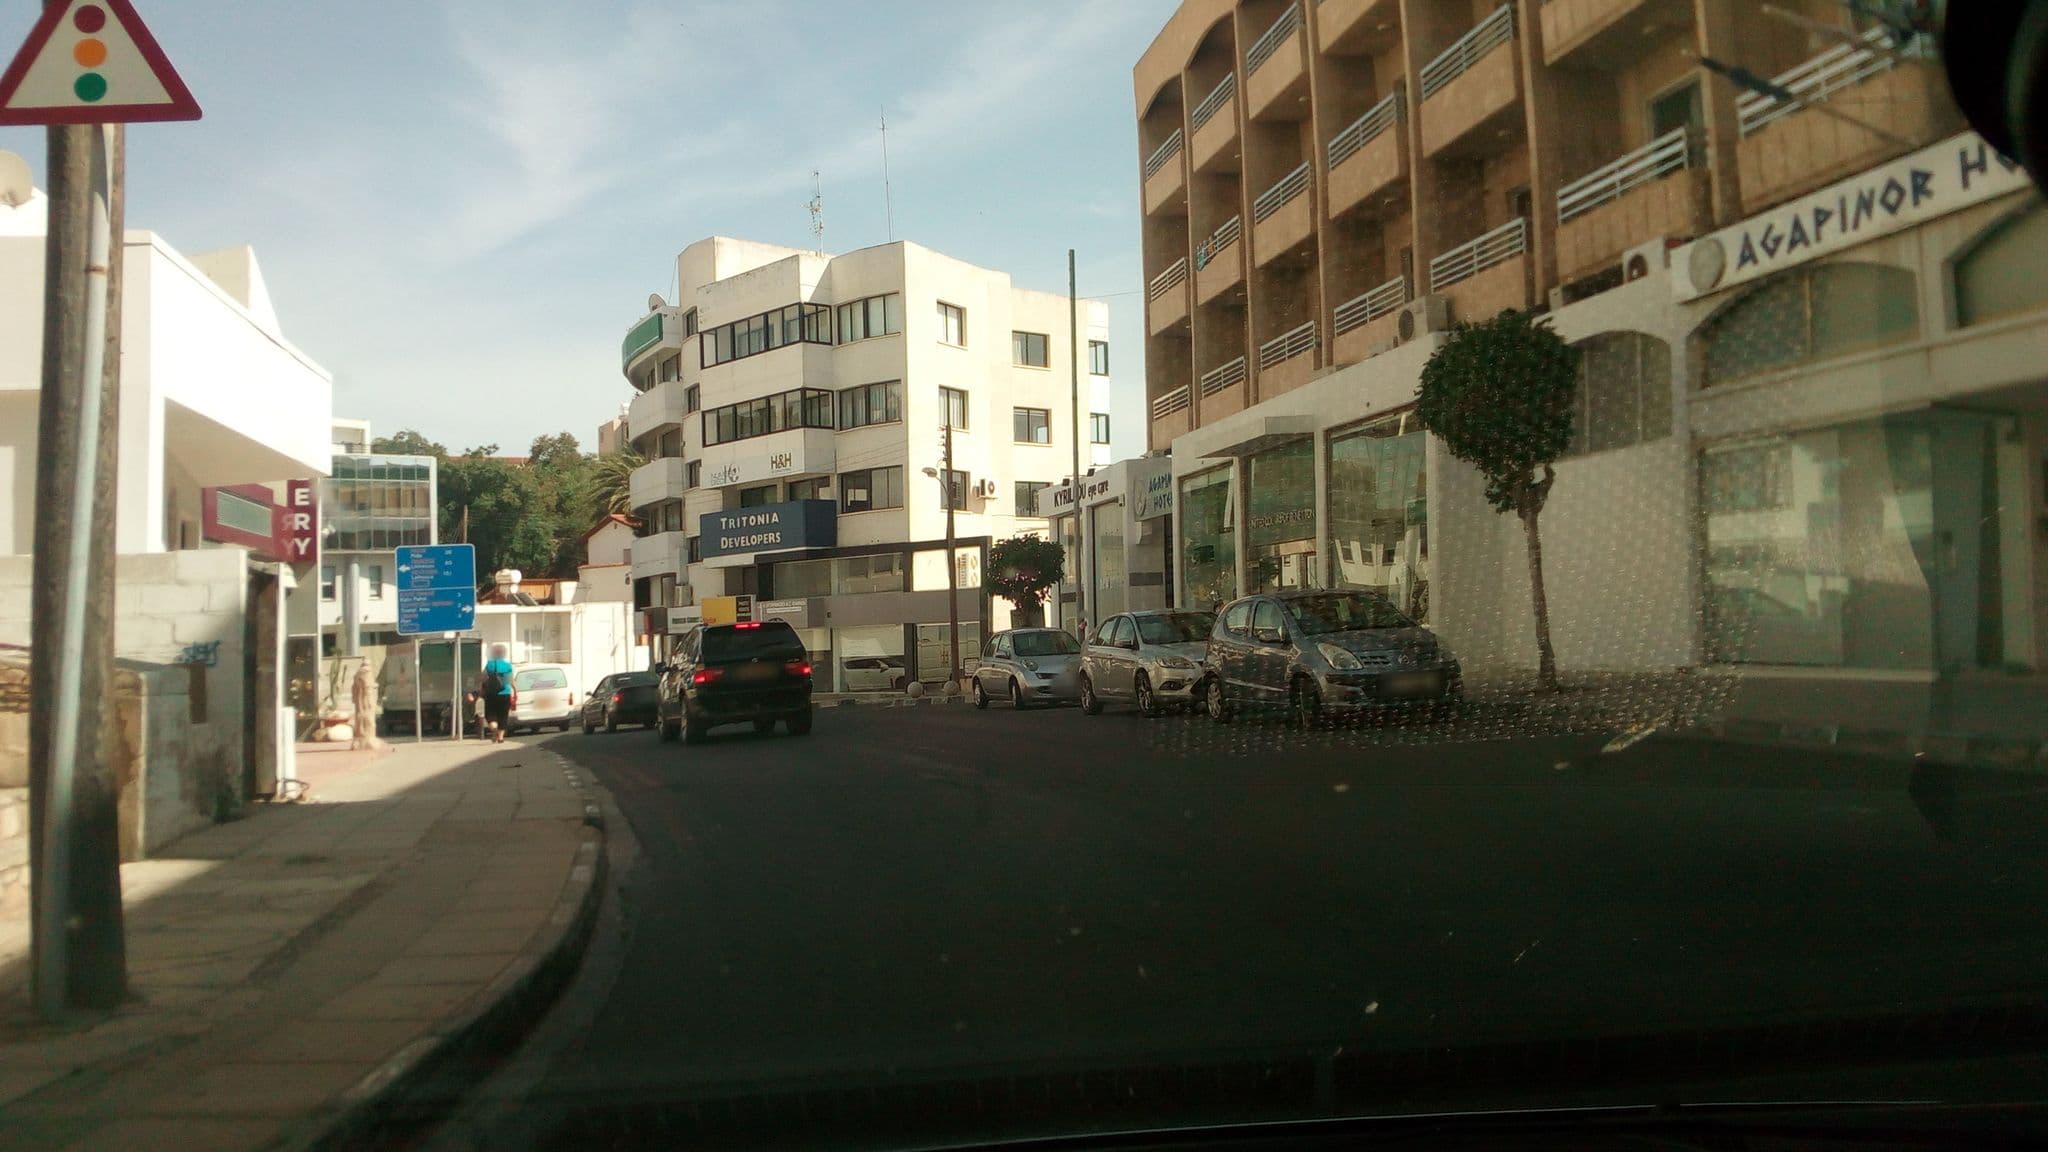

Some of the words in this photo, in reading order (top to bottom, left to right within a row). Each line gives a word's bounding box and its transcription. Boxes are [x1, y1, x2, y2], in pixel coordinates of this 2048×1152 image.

[1736, 168, 1935, 271] AGAPINOR
[770, 452, 793, 470] H&H
[720, 512, 780, 530] TRITONIA
[720, 532, 782, 550] DEVELOPERS
